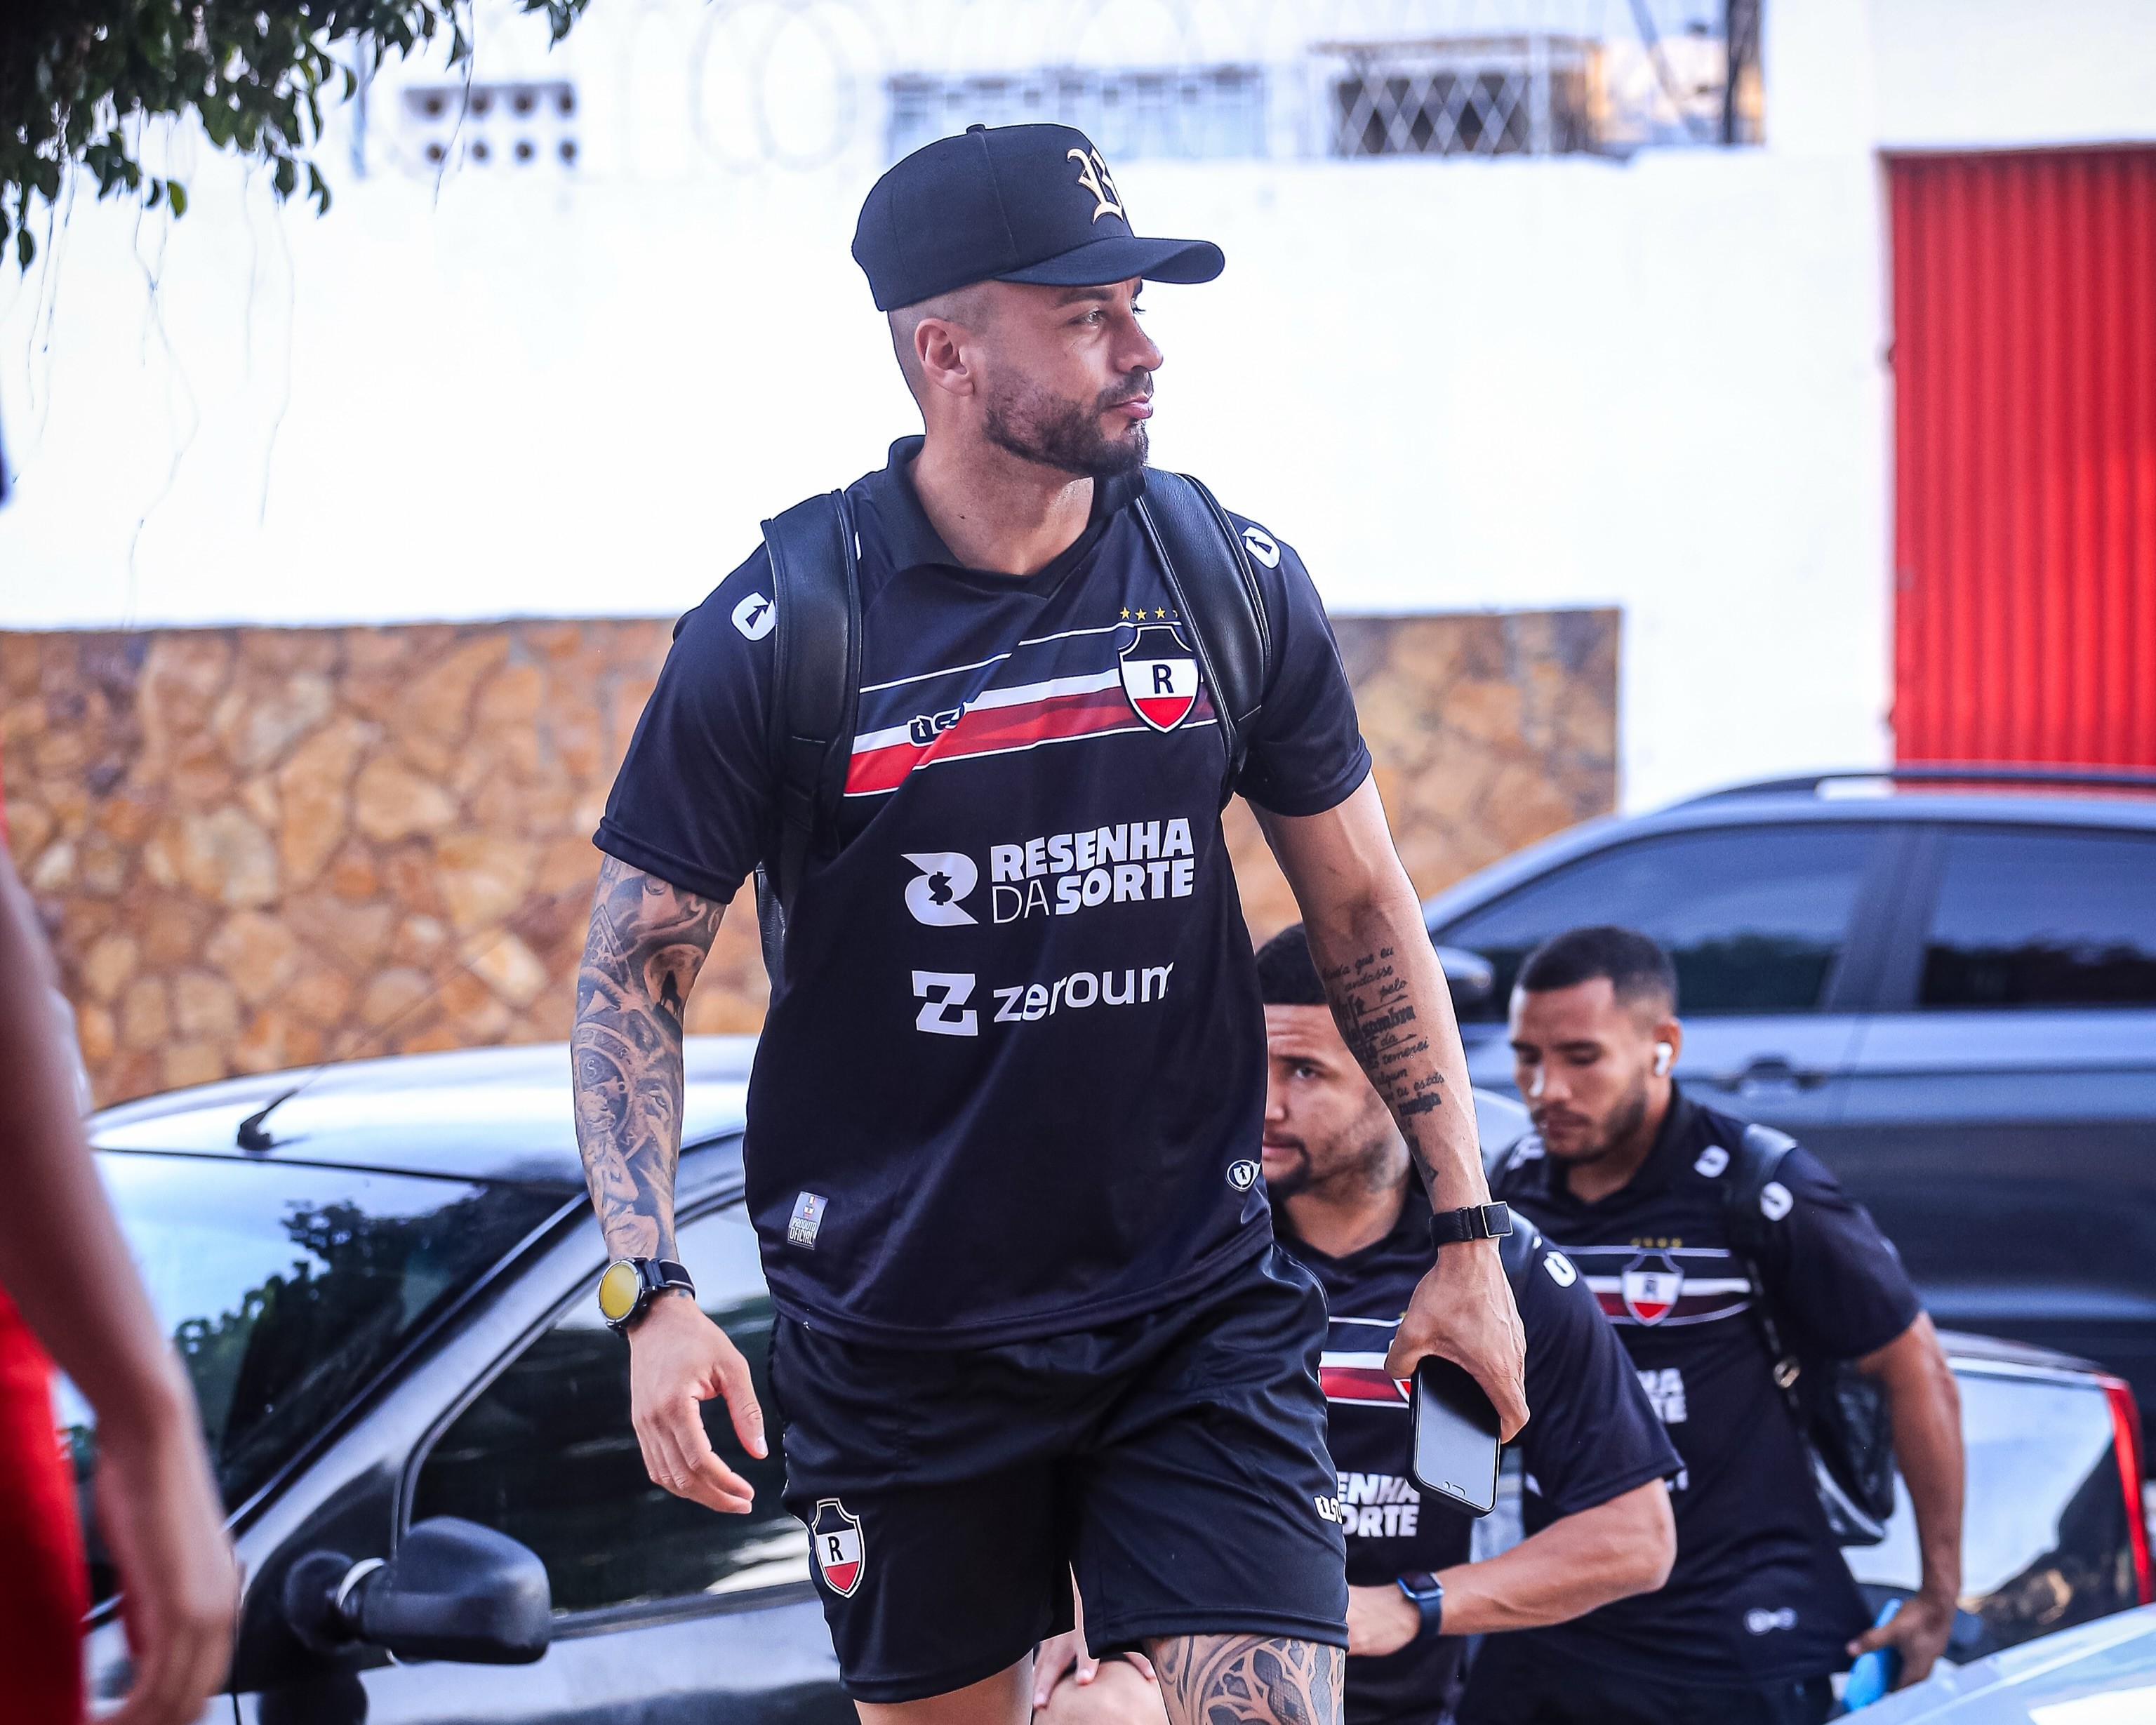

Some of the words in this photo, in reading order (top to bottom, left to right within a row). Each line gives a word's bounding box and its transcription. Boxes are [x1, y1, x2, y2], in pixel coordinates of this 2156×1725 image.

[1152, 665, 1174, 694] R
[990, 818, 1195, 883] RESENHA
[992, 879, 1051, 924] DA
[1055, 858, 1195, 915] SORTE
[789, 1227, 815, 1245] OFICIAL
[791, 1216, 817, 1232] PRODUTO
[827, 1536, 844, 1562] R
